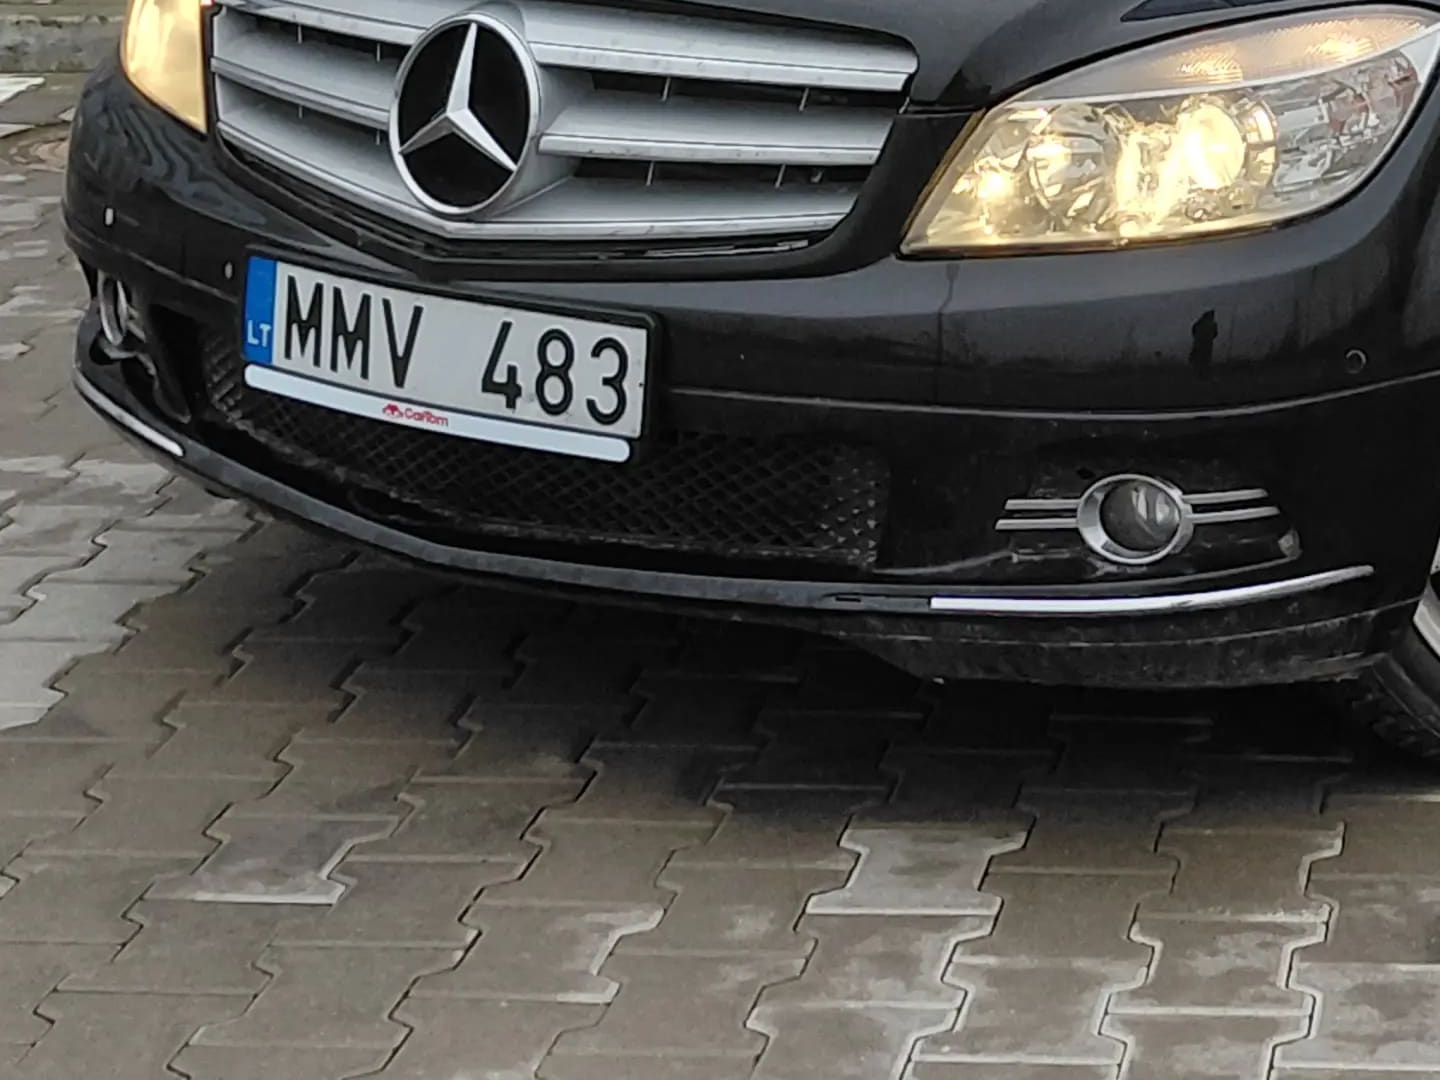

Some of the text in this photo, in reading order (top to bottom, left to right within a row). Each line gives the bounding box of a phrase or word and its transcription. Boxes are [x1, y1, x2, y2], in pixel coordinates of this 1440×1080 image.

[247, 319, 272, 348] LT
[284, 275, 630, 426] MMV 483
